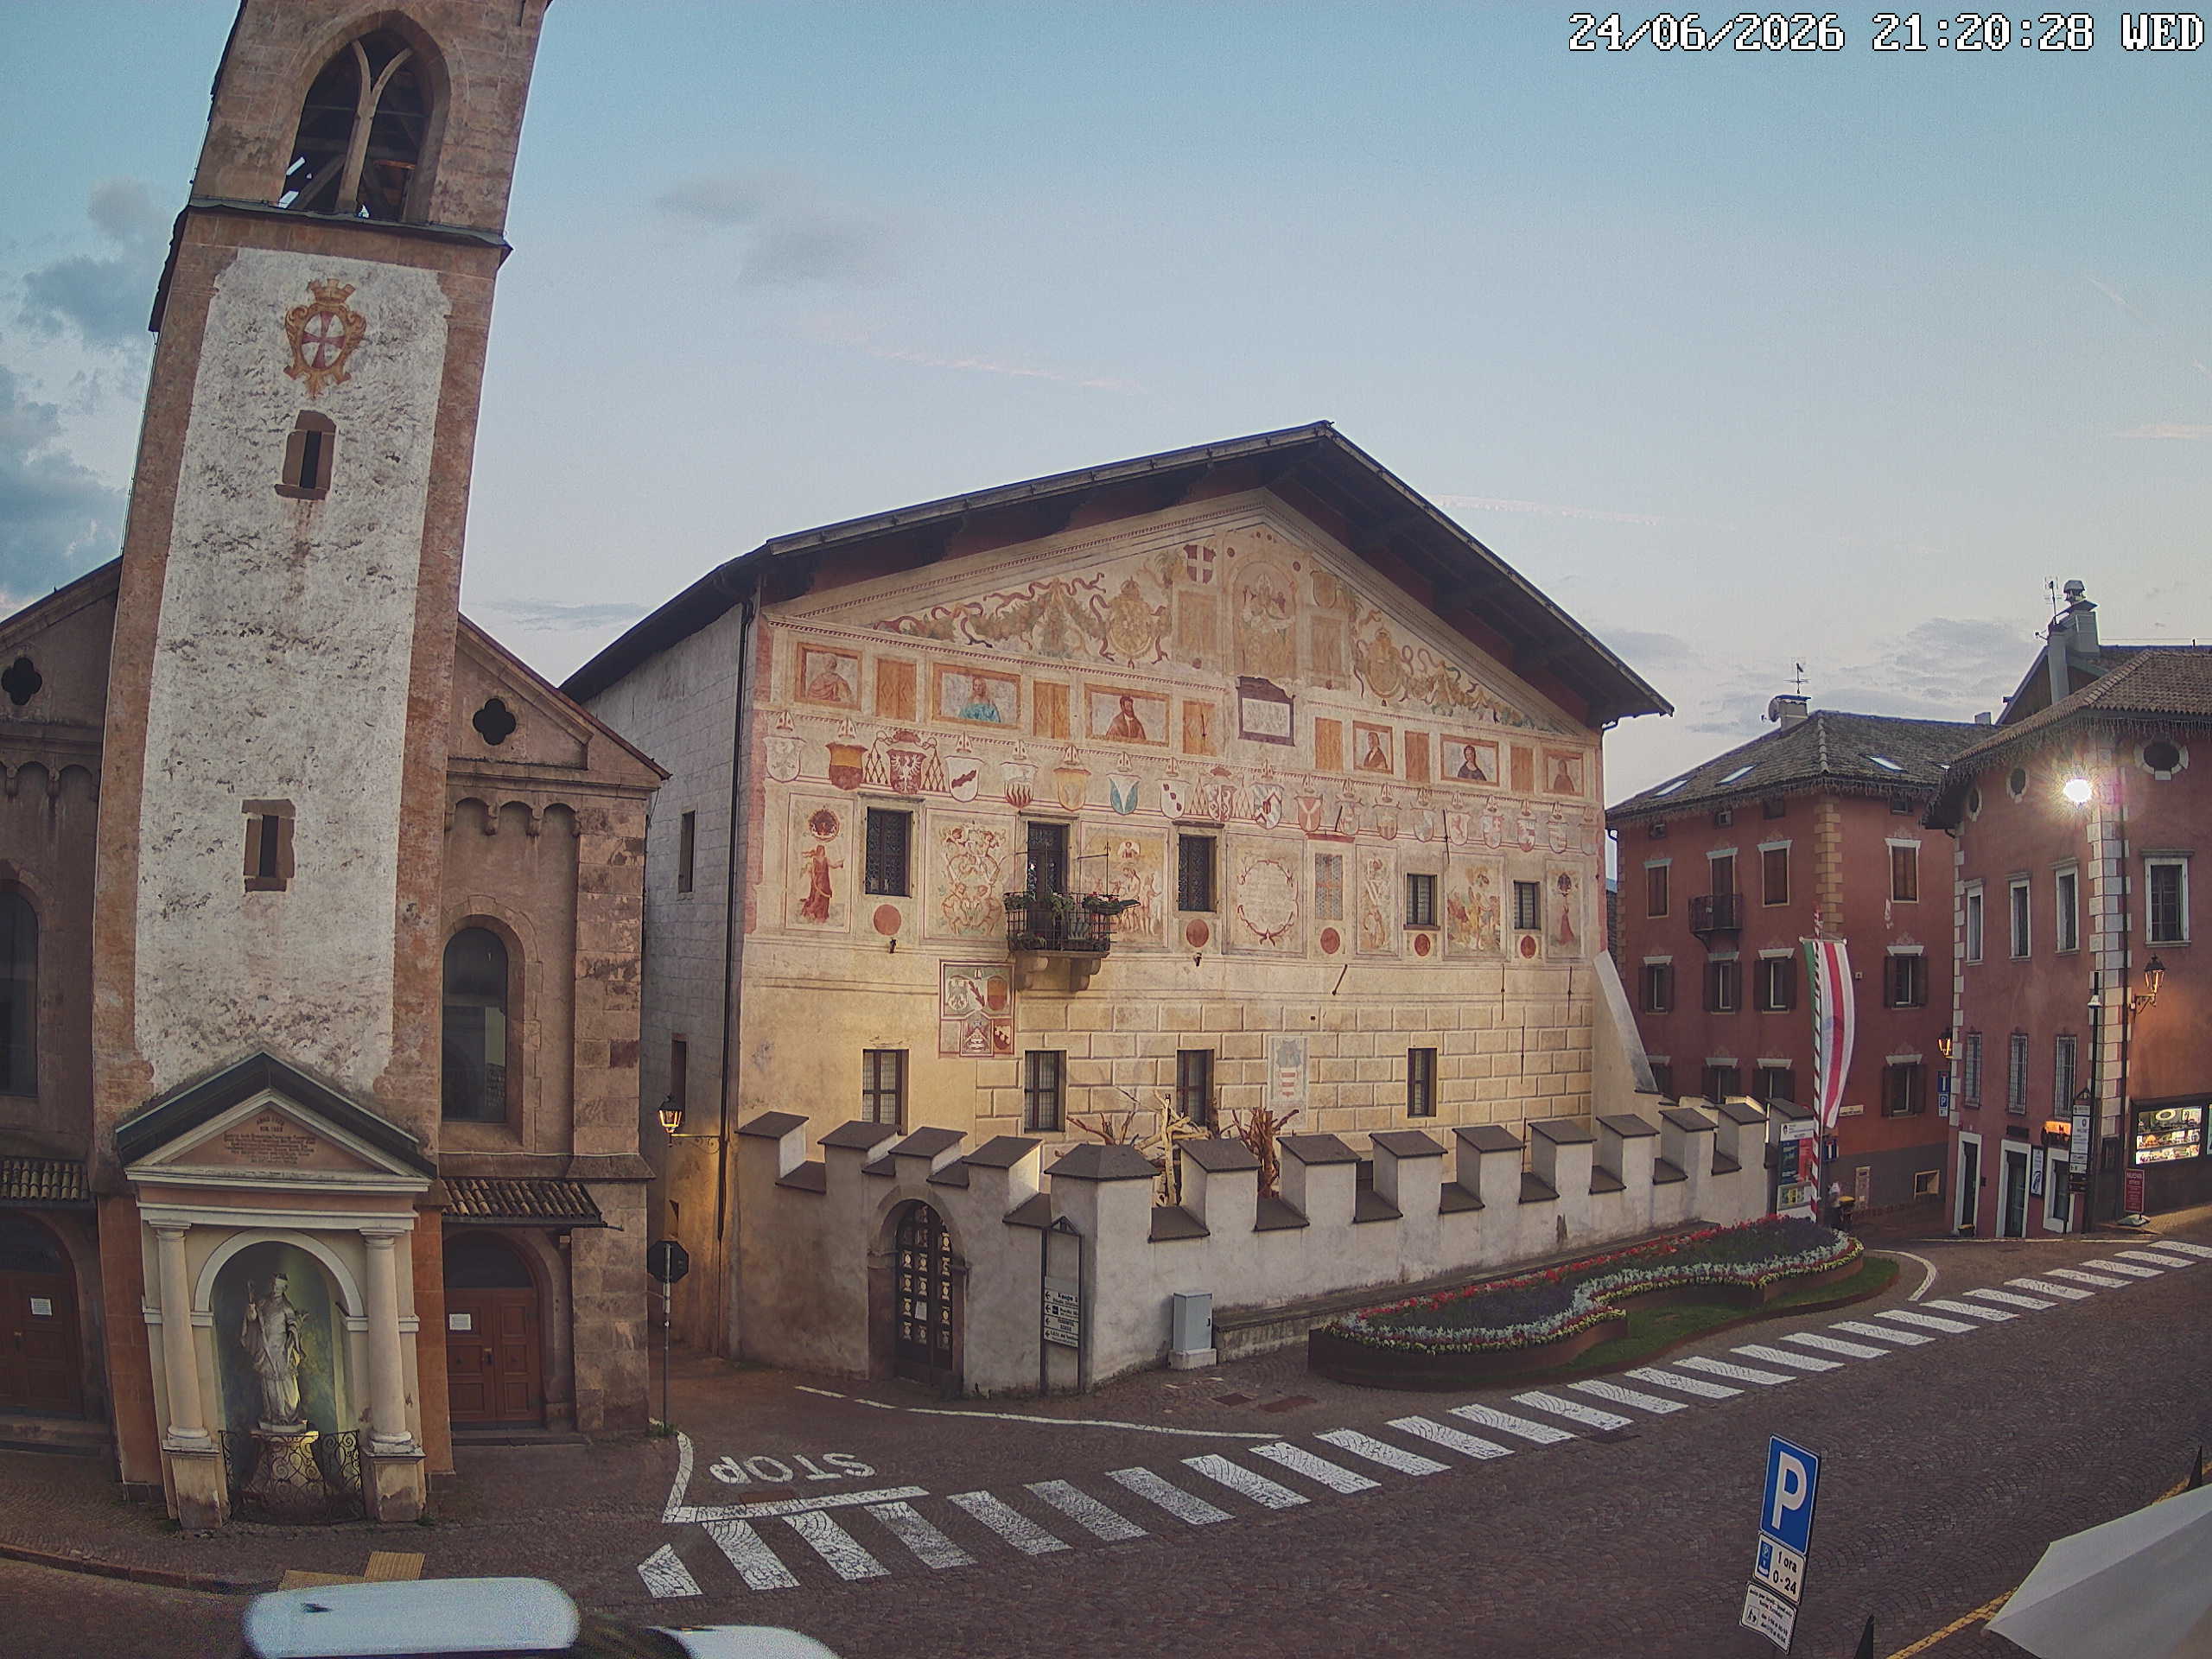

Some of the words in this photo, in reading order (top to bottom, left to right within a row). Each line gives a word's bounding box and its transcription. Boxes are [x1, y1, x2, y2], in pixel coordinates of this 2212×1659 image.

[709, 1452, 877, 1485] STOP
[1771, 1451, 1808, 1530] P
[1777, 1550, 1783, 1564] 1
[1783, 1557, 1797, 1573] ora
